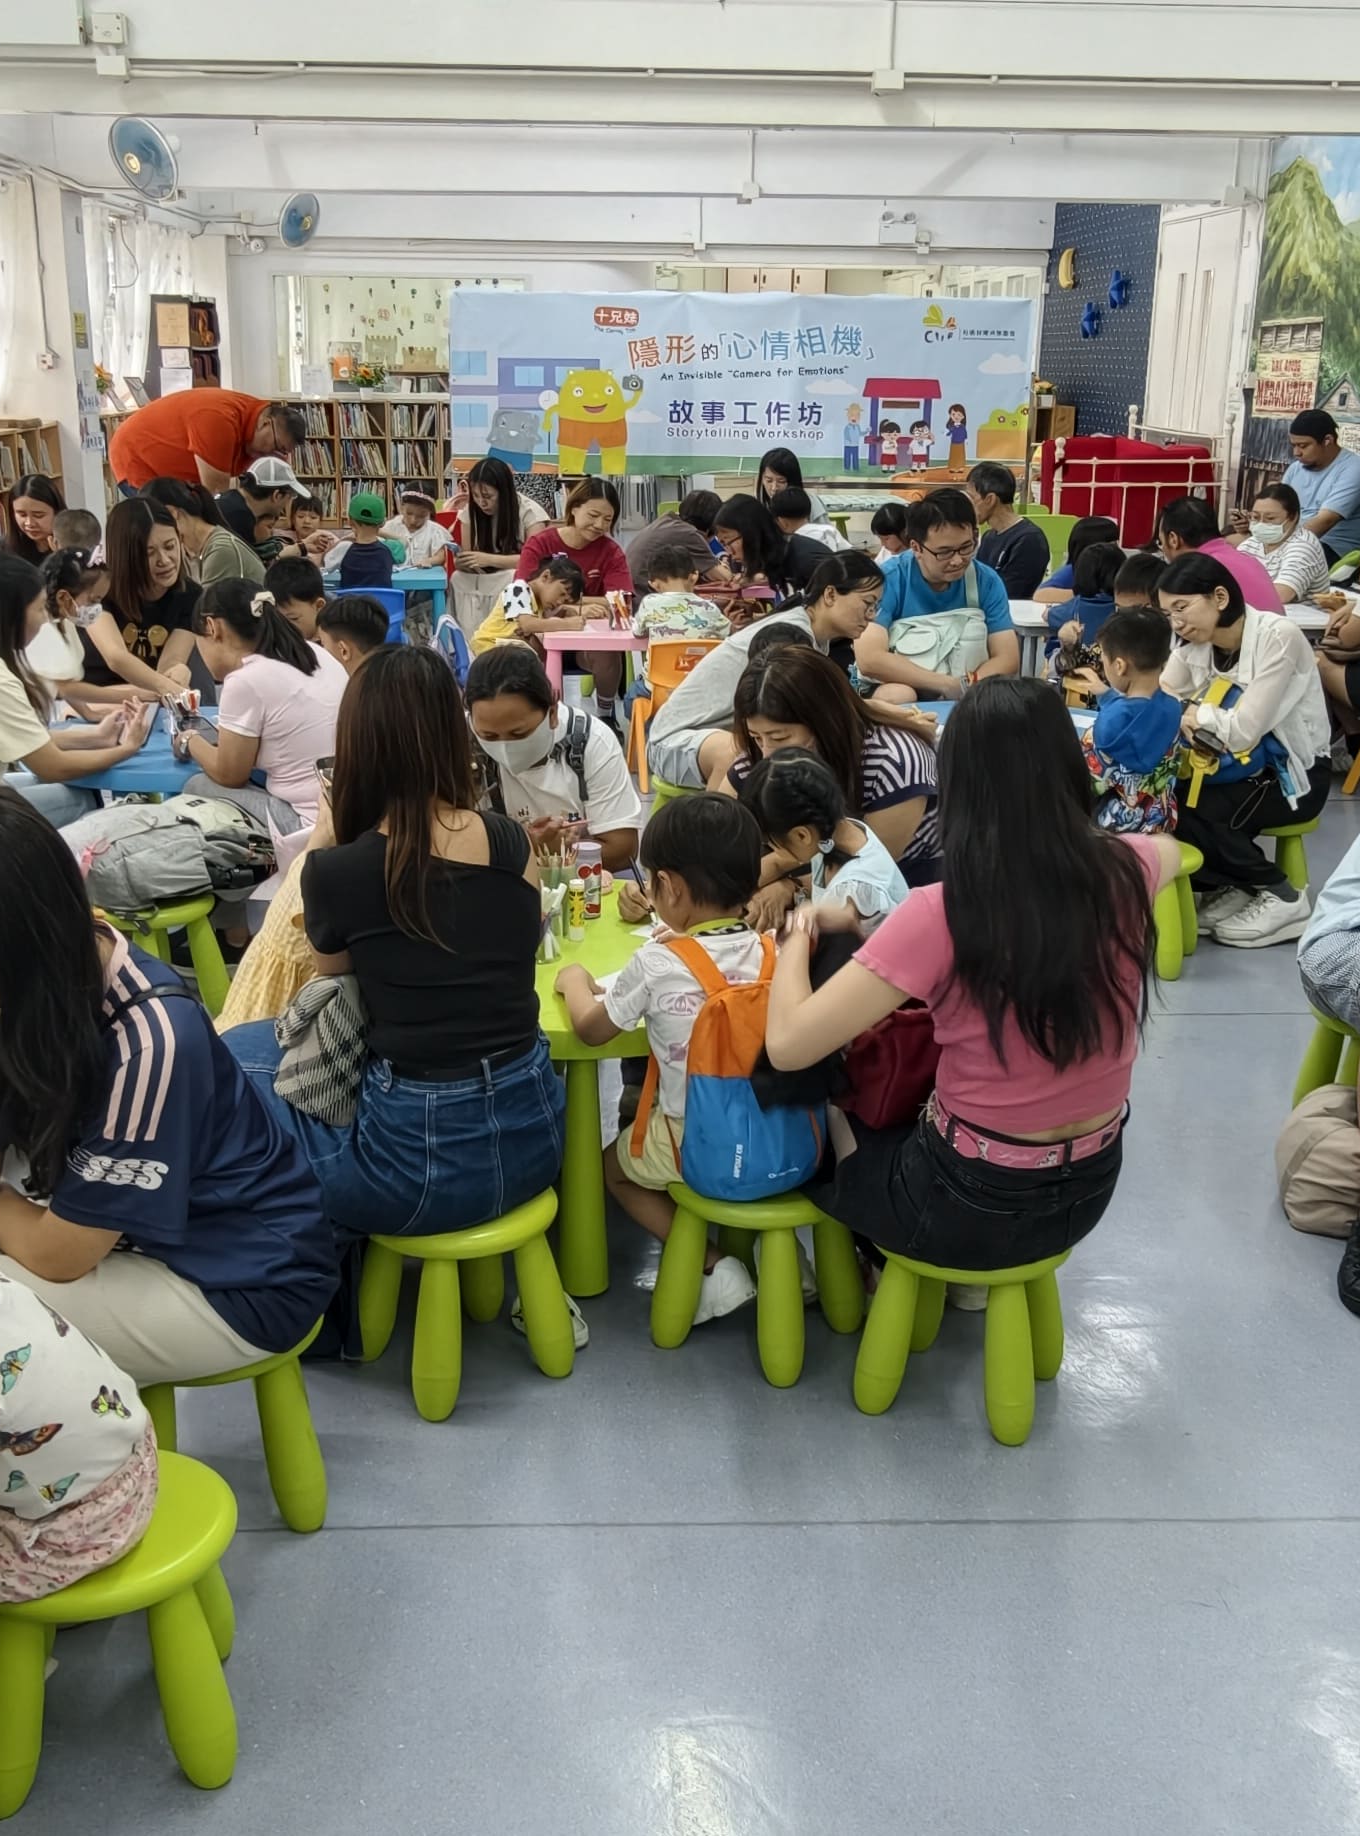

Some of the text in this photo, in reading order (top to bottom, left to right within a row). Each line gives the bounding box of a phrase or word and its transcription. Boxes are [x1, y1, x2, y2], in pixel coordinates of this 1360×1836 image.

[595, 309, 638, 325] 十兄妹
[627, 323, 875, 371] 隱形的「心情相機」
[660, 372, 674, 381] An
[678, 370, 723, 380] Invisible
[776, 367, 793, 377] for
[668, 400, 824, 426] 故事工作坊
[666, 427, 824, 441] Storytelling Workshop
